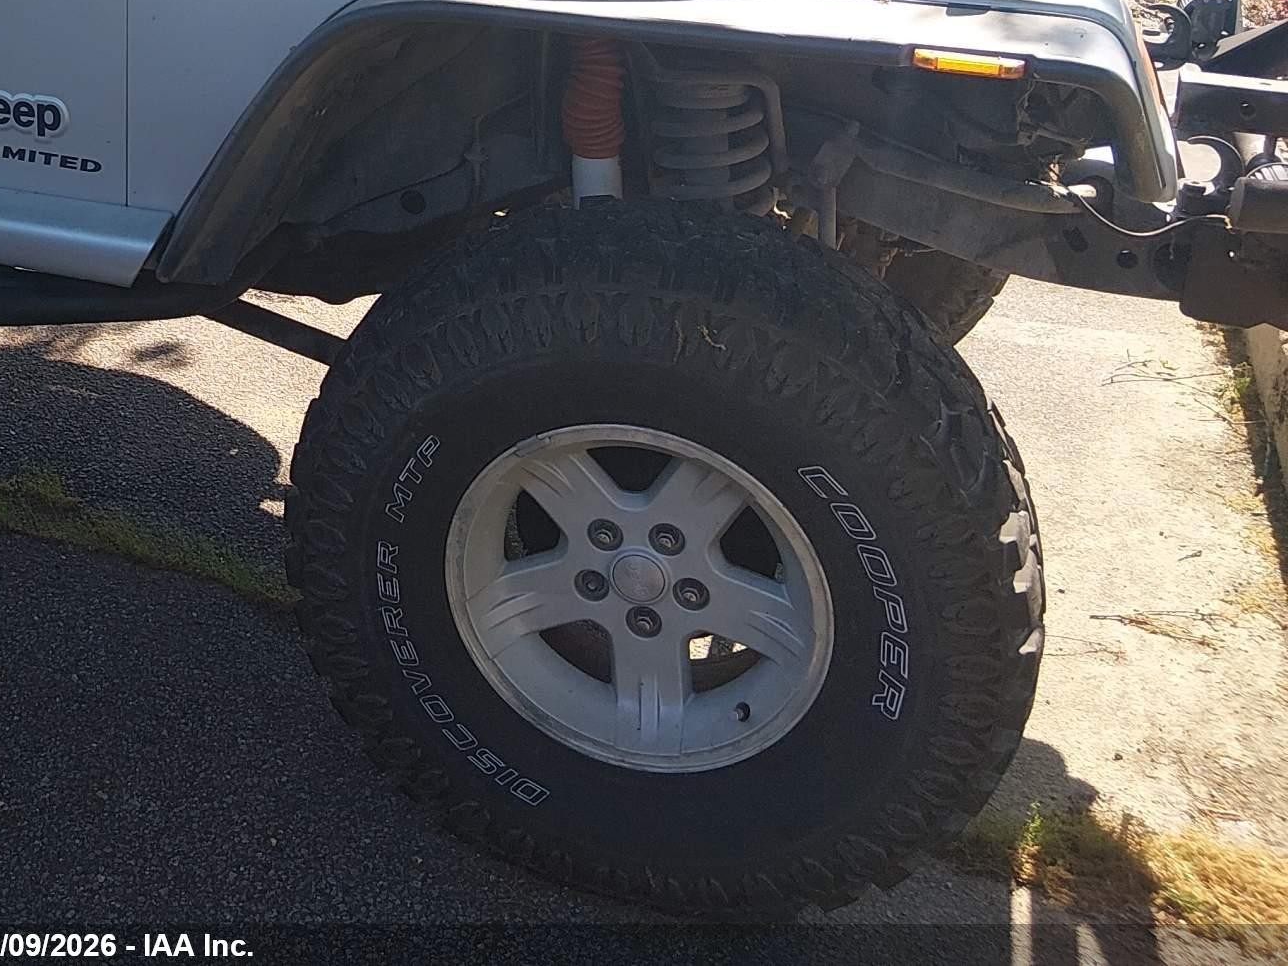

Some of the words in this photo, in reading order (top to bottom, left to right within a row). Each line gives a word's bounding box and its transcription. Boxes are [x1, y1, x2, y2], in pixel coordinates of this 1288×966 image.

[385, 435, 441, 523] MTP
[798, 466, 909, 721] COOPER
[377, 540, 550, 807] DISCOVERER
